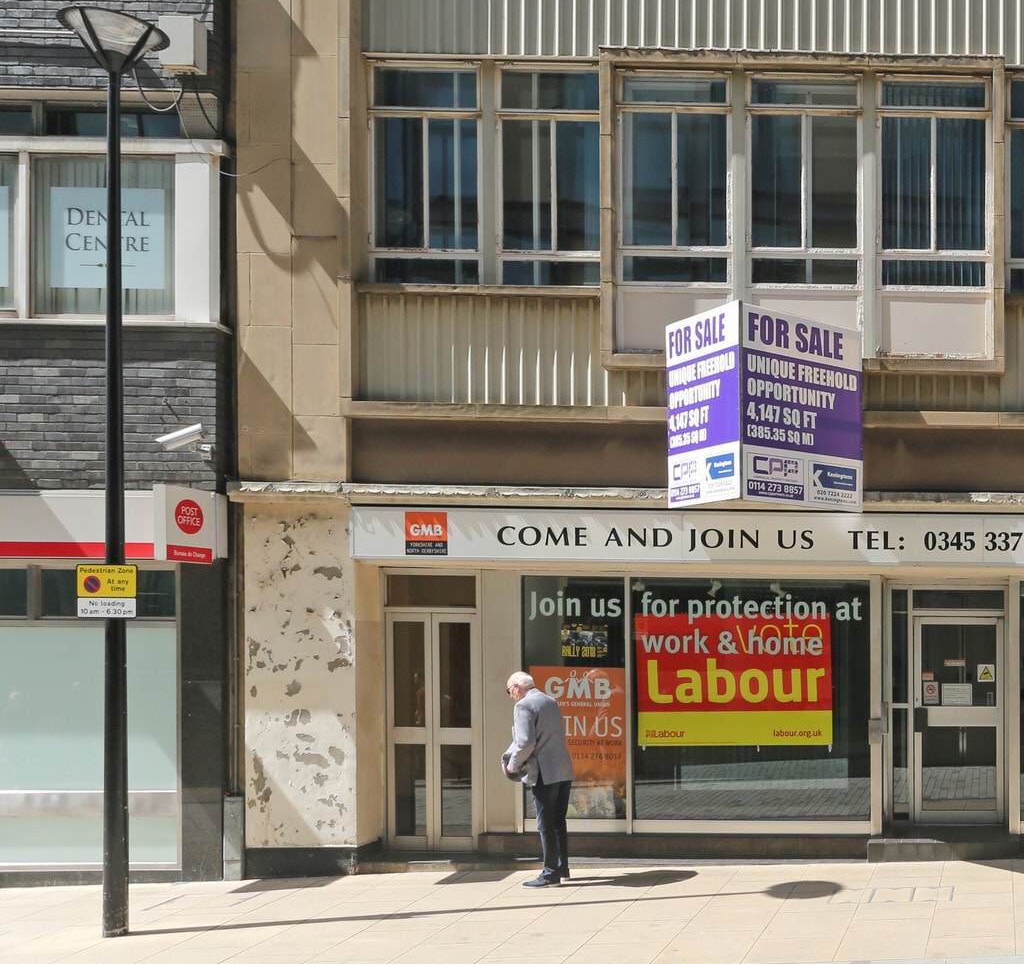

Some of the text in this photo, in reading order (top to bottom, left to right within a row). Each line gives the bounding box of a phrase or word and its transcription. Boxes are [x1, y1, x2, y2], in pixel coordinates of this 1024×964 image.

[65, 232, 150, 252] CENRE
[669, 313, 726, 358] FOR SALE
[748, 312, 844, 360] FOR SALE
[668, 351, 736, 388] UNIQUE FREEHOLD
[746, 354, 858, 392] UNIQUE FREEHOLD
[669, 378, 721, 410] OPPORTUNITY
[746, 377, 836, 410] OPPORTUNITY
[668, 405, 710, 433] 4,147 SQ FT
[746, 401, 818, 430] 4,147 SQ FT
[746, 424, 815, 446] (385.35 SQ M)
[753, 455, 799, 477] CPP
[826, 471, 853, 480] Keningtons
[748, 480, 766, 491] 0114
[768, 482, 782, 493] 273
[784, 484, 803, 495] 8857
[177, 516, 201, 526] OFFICE
[181, 506, 198, 516] POST
[410, 524, 443, 536] GMB
[496, 526, 588, 547] COME
[604, 526, 673, 548] AND
[688, 528, 760, 553] JOIN
[776, 529, 814, 550] US
[847, 530, 906, 551] TEL:
[923, 531, 976, 552] 0345
[984, 532, 1024, 553] 337
[173, 549, 188, 557] Bureau
[100, 600, 126, 608] loading
[528, 590, 622, 621] Join us
[641, 592, 862, 625] for protection at
[561, 645, 580, 657] RALLY
[582, 646, 596, 658] 2018
[641, 628, 824, 656] work & home
[544, 676, 612, 700] GMB
[646, 658, 826, 704] Labour
[594, 716, 622, 738] US
[654, 729, 685, 738] Labour
[772, 729, 822, 738] labour.org.uk
[572, 752, 588, 760] 0114
